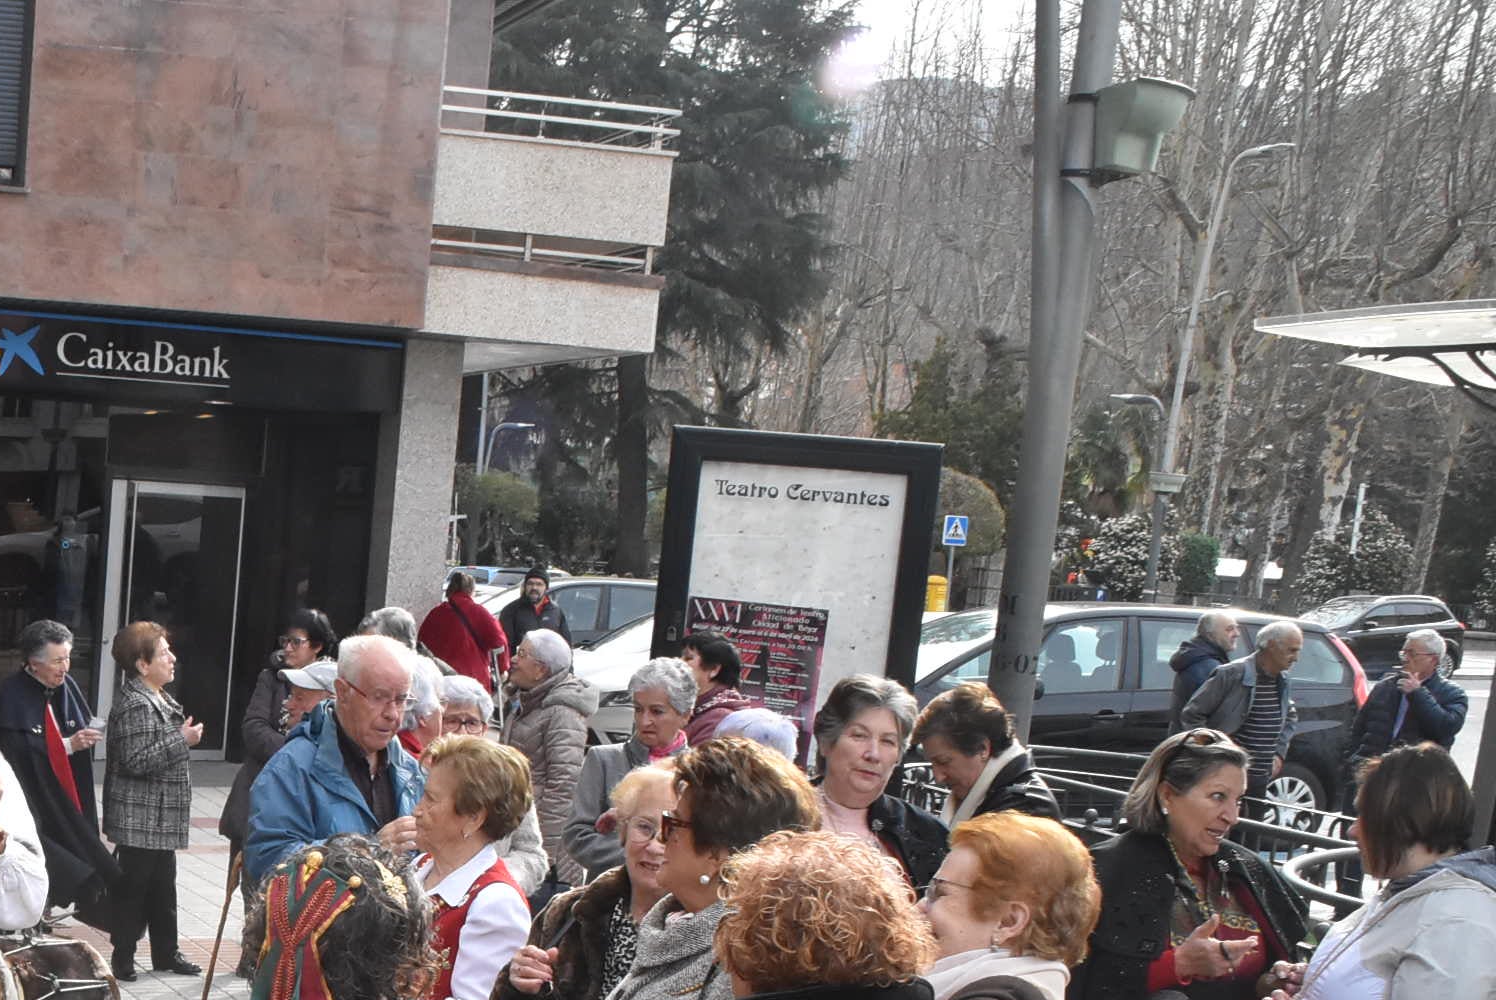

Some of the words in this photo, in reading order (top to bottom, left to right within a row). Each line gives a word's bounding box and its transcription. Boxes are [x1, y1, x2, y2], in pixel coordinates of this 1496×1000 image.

[56, 332, 230, 379] CaixaBank
[715, 479, 779, 498] Teatro
[786, 484, 890, 507] Cervantes
